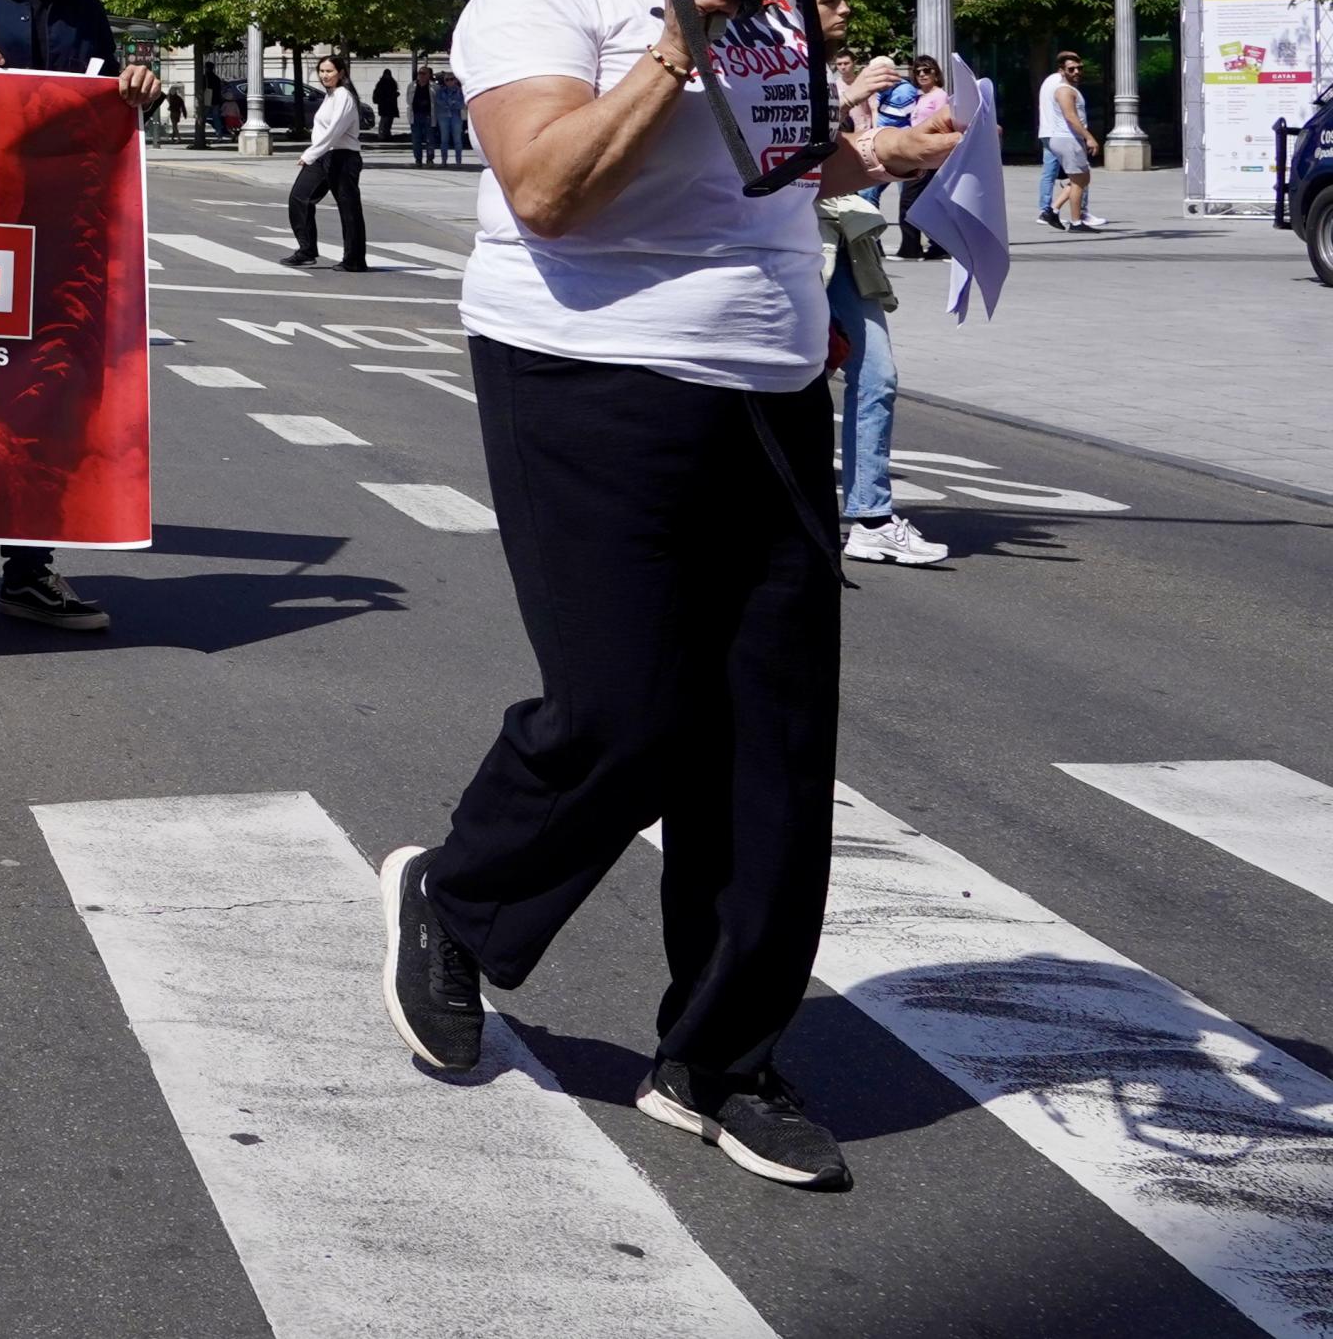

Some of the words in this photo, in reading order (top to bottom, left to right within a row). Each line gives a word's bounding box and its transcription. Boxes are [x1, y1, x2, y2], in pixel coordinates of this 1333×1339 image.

[761, 84, 797, 102] SUBIR
[751, 105, 810, 123] CONTENER
[771, 123, 797, 145] MÁS
